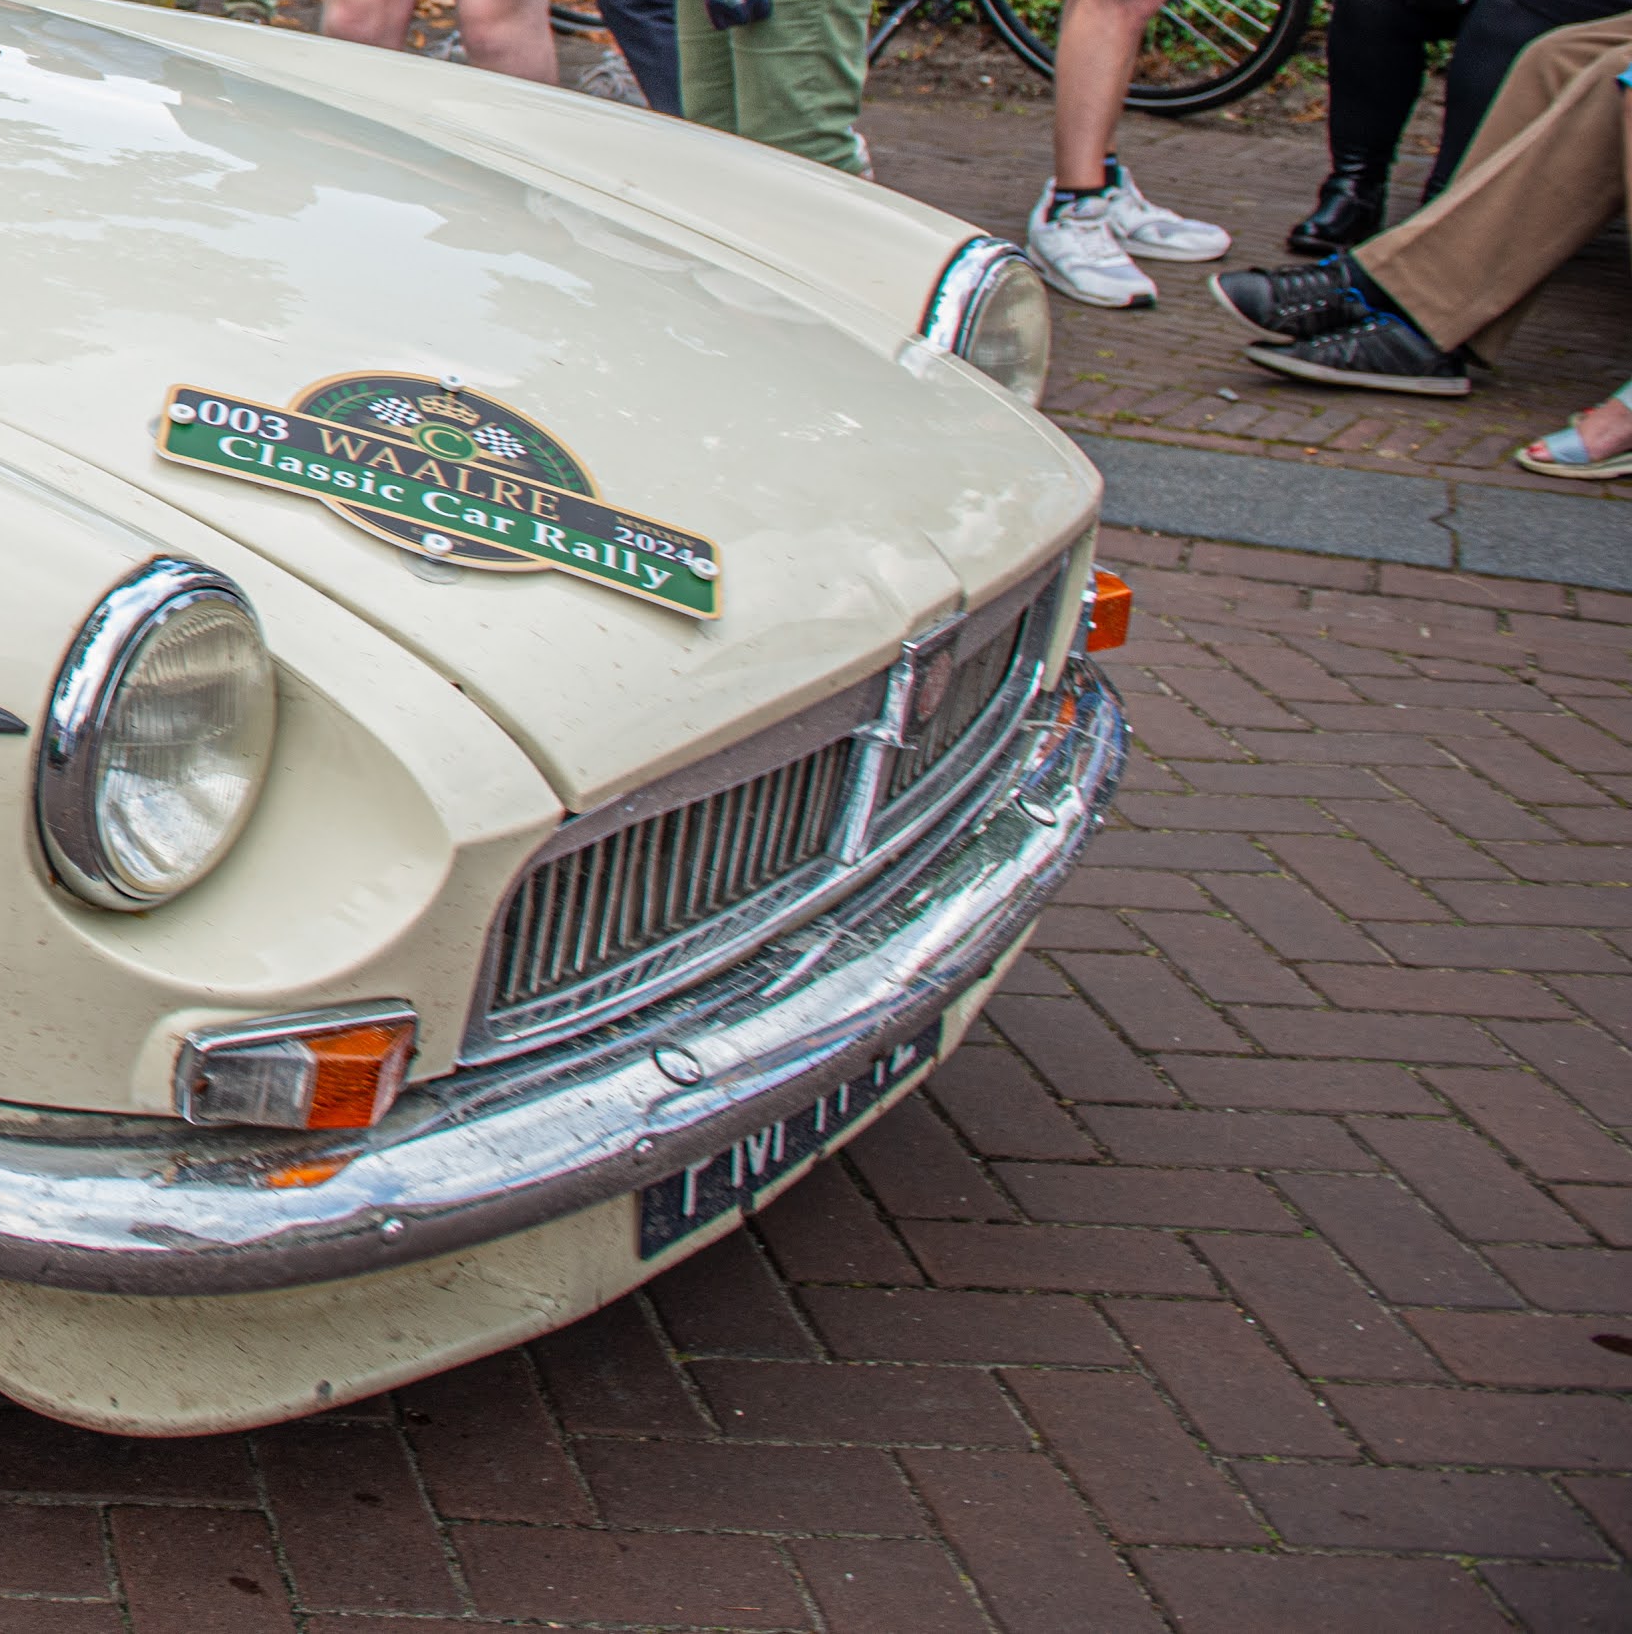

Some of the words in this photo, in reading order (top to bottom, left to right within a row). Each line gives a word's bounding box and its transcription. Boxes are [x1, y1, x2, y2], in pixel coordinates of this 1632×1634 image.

[197, 398, 289, 441] 003
[316, 427, 563, 523] WAALRE
[216, 433, 406, 504] Classic
[420, 490, 517, 536] Car
[529, 521, 676, 591] Rally
[612, 525, 696, 567] 2024
